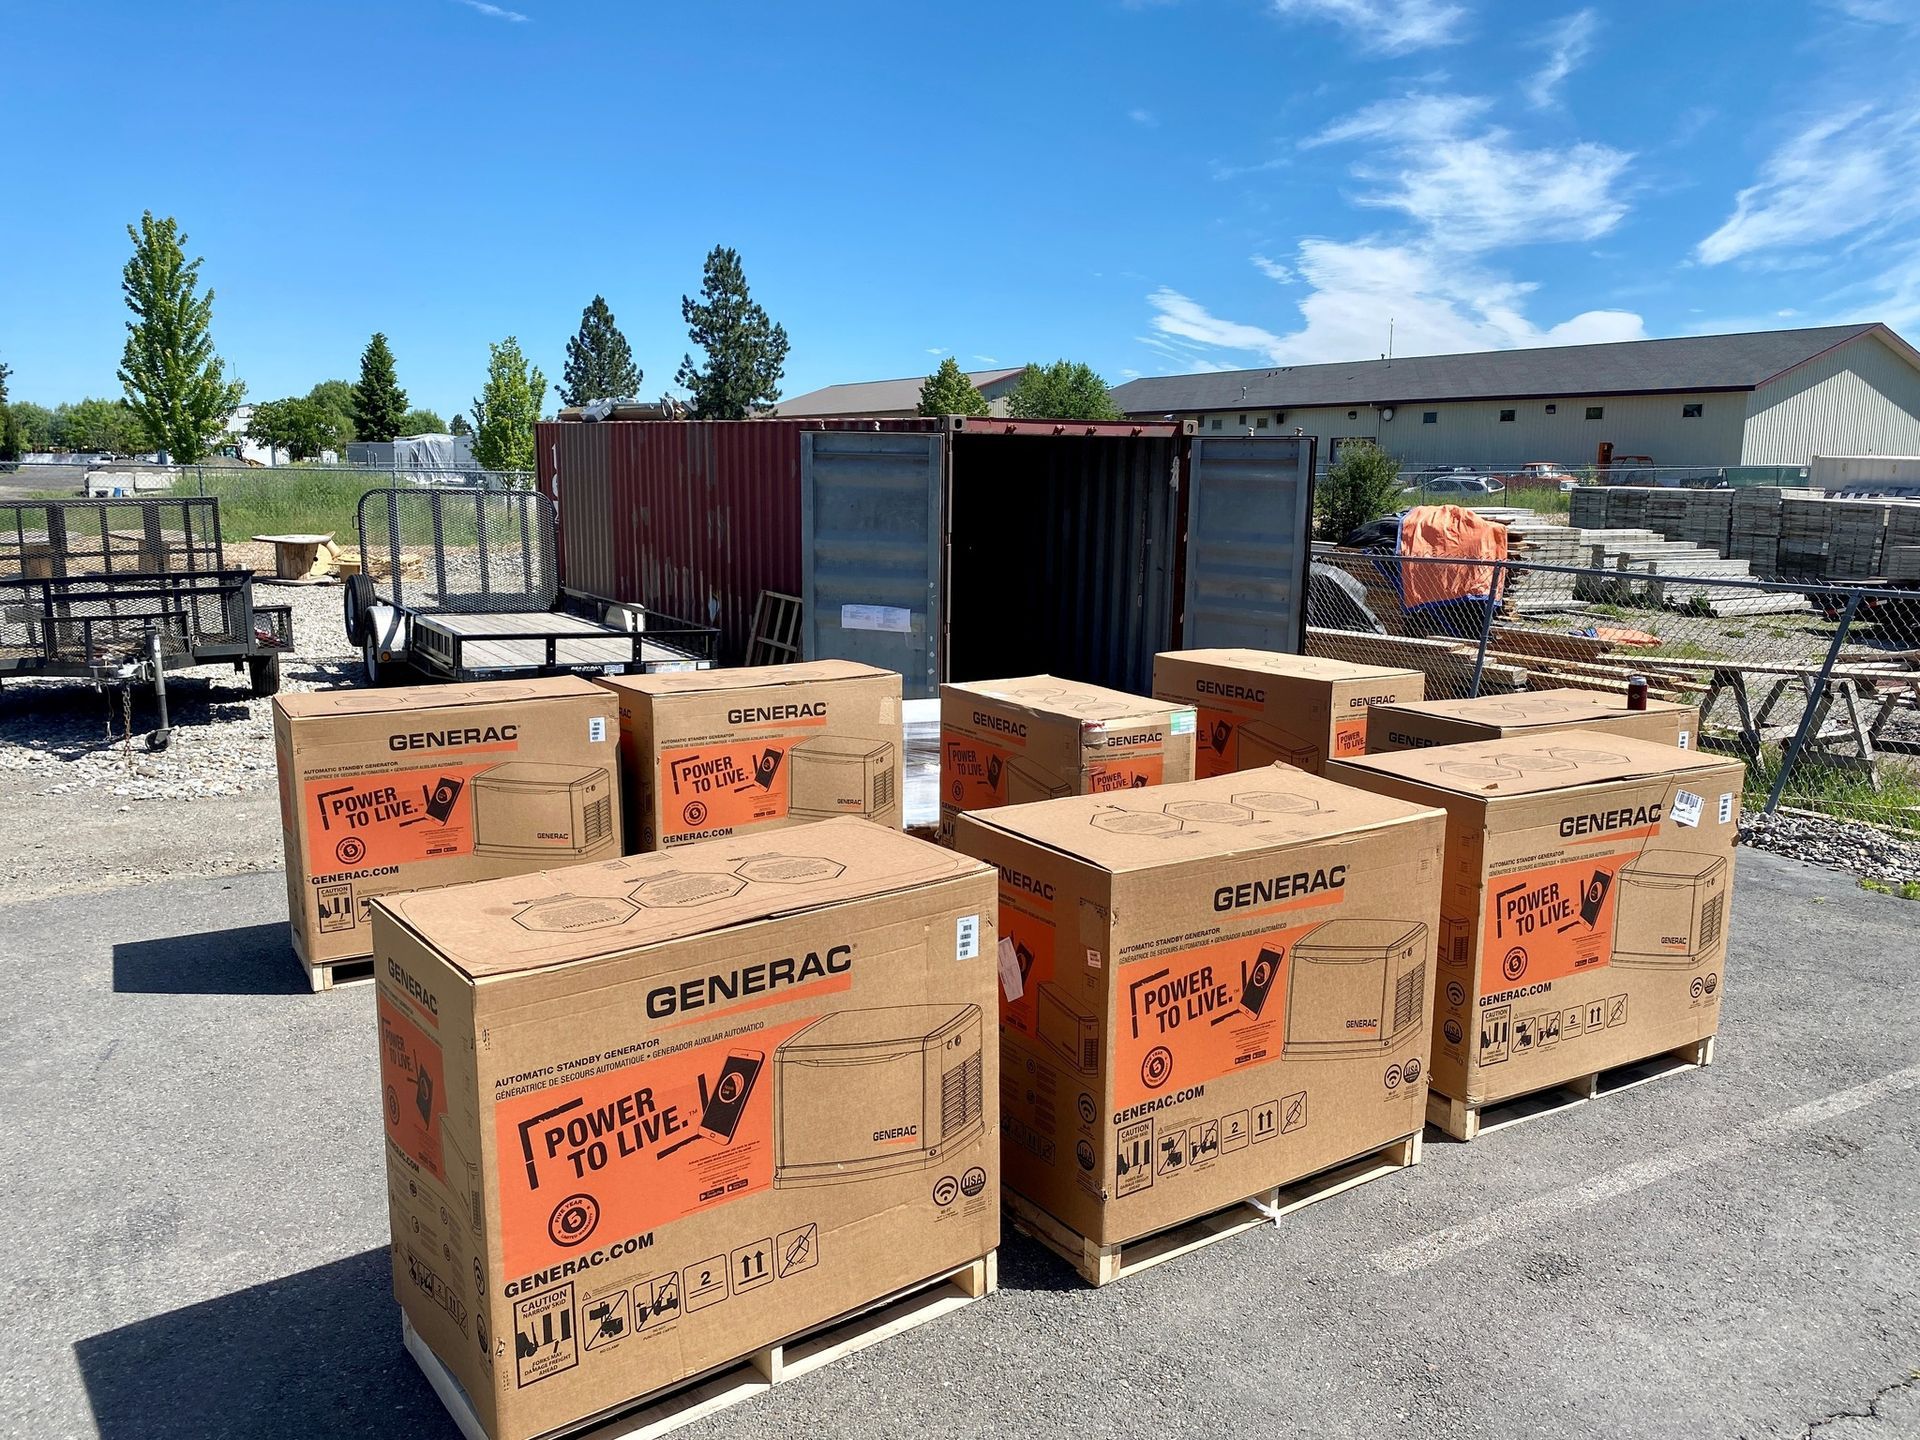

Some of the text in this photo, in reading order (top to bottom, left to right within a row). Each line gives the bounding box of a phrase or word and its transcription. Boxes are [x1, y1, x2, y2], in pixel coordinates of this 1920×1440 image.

[1196, 680, 1265, 702] GENERAC
[1350, 695, 1396, 708] GENERAC
[728, 702, 827, 724] GENERAC
[973, 711, 1027, 737] GENERAC
[389, 725, 518, 751] GENERAC
[1107, 733, 1162, 747] GENERAC
[1340, 731, 1361, 744] POWER
[1344, 742, 1351, 750] TO
[952, 750, 976, 763] POWER
[682, 756, 733, 781] POWER
[957, 763, 966, 775] TO
[1097, 771, 1122, 785] POWER
[692, 768, 749, 793] TO LIVE.
[1102, 784, 1111, 792] TO
[333, 786, 397, 816] POWER
[345, 799, 418, 829] TO LIVE.
[1560, 804, 1662, 838] GENERAC
[537, 832, 568, 840] GENERAC
[663, 828, 733, 843] GENERAC.COM
[1489, 851, 1565, 868] AUTOMATIC STANDBY GENERATOR
[312, 866, 399, 885] GENERAC.COM
[321, 886, 348, 895] CAUTION
[1214, 865, 1346, 912] GENERAC
[1507, 882, 1560, 920] POWER
[1516, 899, 1574, 936] TO LIVE.
[1119, 928, 1220, 955] AUTOMATIC STANDBY GENERATOR
[1661, 937, 1687, 945] GENERAC
[388, 957, 438, 1016] GENERAC
[646, 945, 852, 1020] GENERAC
[1144, 966, 1213, 1015] POWER
[1479, 982, 1552, 1007] GENERAC.COM
[1156, 1005, 1180, 1034] TO
[1187, 983, 1233, 1021] LIVE.
[1485, 1008, 1508, 1019] CAUTION
[1346, 1019, 1377, 1028] GENERAC
[1570, 1014, 1576, 1024] 2
[384, 1028, 406, 1048] POWER
[495, 1038, 660, 1089] AUTOMATIC STANDBY GENERATOR
[549, 1076, 559, 1087] DE
[560, 1068, 595, 1084] SECOURS
[596, 1054, 645, 1075] AUTOMATIQUE
[652, 1041, 693, 1059] GENERADOR
[694, 1033, 723, 1047] AUXILIAR
[1153, 1060, 1161, 1074] 5
[1405, 1065, 1418, 1076] USA
[1113, 1085, 1205, 1125] GENERAC.COM
[545, 1087, 656, 1160] POWER
[873, 1125, 917, 1142] GENERAC
[1121, 1123, 1149, 1139] CAUTION
[1232, 1121, 1238, 1133] 2
[567, 1141, 608, 1179] TO
[616, 1105, 689, 1158] LIVE.
[965, 1173, 982, 1187] USA
[555, 1199, 583, 1223] FIVE YEAR
[567, 1210, 582, 1228] 5
[504, 1232, 654, 1298] GENERAC.COM
[701, 1271, 711, 1286] 2
[521, 1289, 567, 1313] CAUTION
[523, 1299, 566, 1319] NARROW SKID
[524, 1354, 571, 1376] DAMAGE FREIGHT
[532, 1352, 562, 1367] FORKS MAY
[539, 1365, 558, 1376] AHEAD
